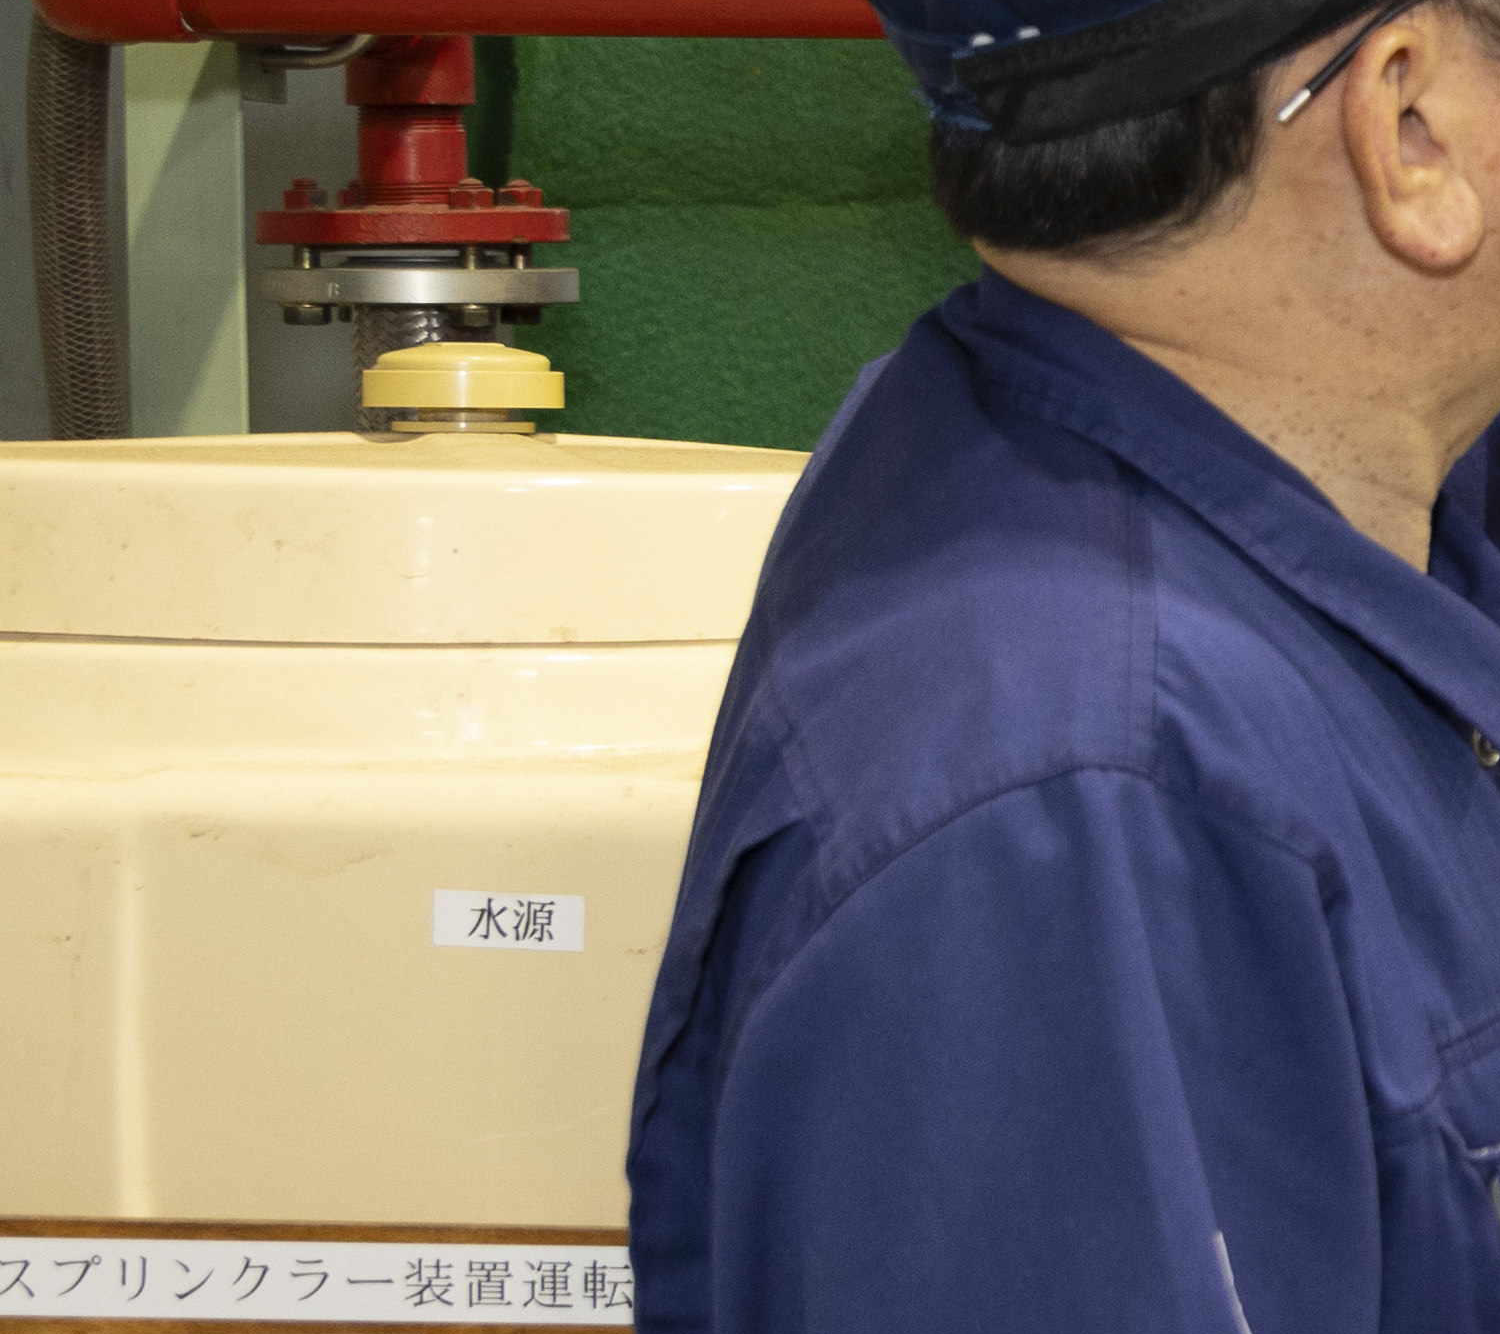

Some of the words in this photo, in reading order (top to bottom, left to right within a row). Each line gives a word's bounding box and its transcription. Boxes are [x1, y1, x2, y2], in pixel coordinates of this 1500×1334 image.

[468, 898, 556, 945] 水源
[0, 1254, 635, 1312] スプリンクラー装置運転
